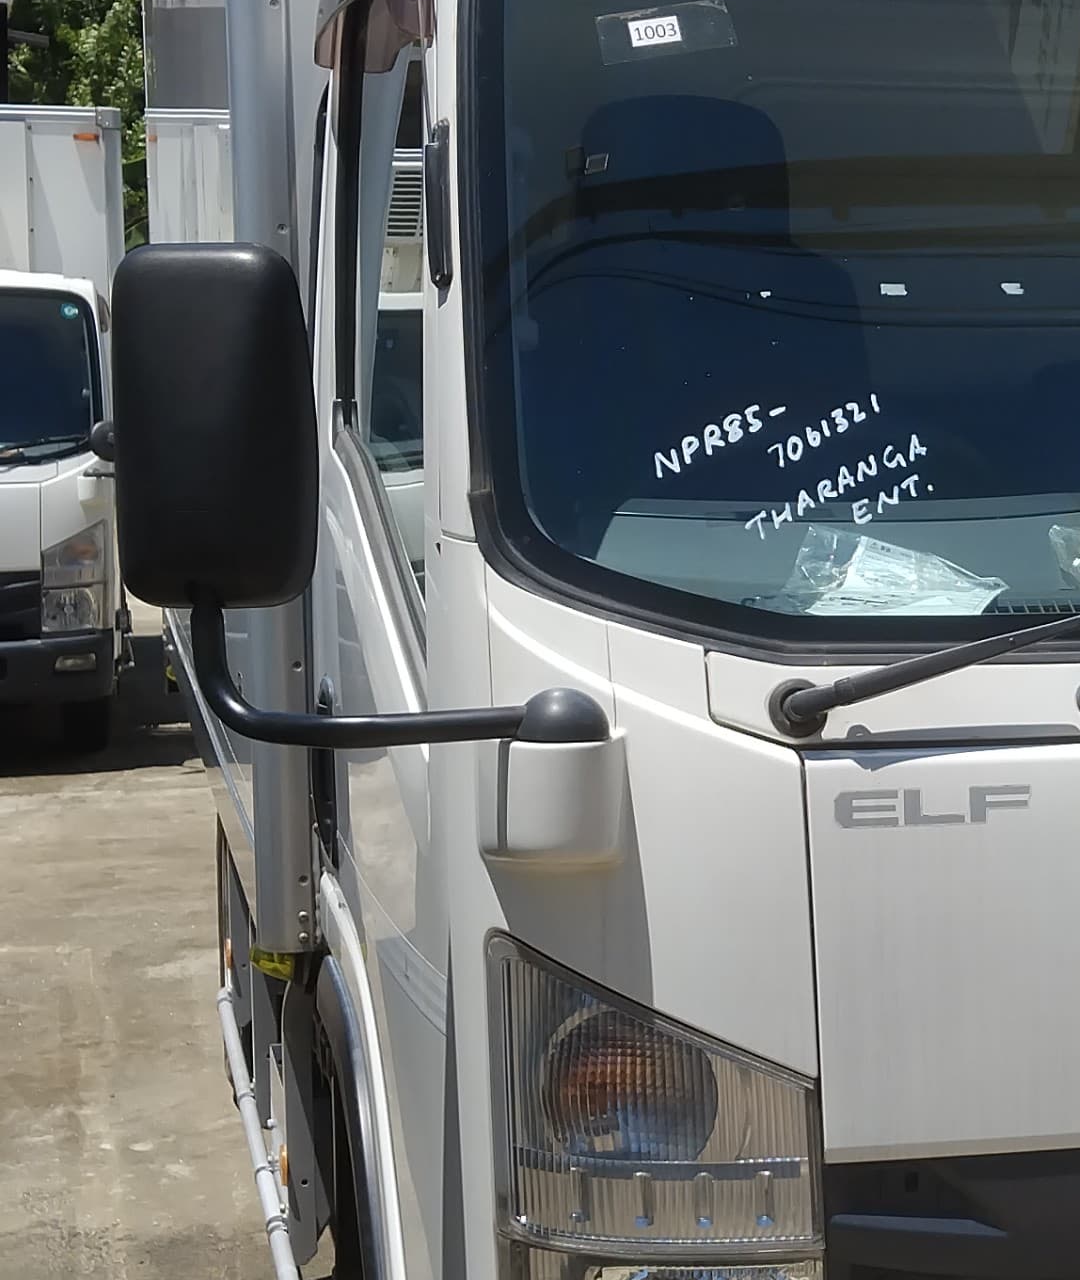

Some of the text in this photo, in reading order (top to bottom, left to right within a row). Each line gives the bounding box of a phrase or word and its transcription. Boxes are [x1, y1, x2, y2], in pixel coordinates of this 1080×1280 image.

[634, 22, 678, 42] 1003
[767, 393, 881, 469] 7061321
[744, 433, 928, 540] THARANGA
[851, 473, 935, 526] ENT.
[833, 784, 1032, 829] ELF
